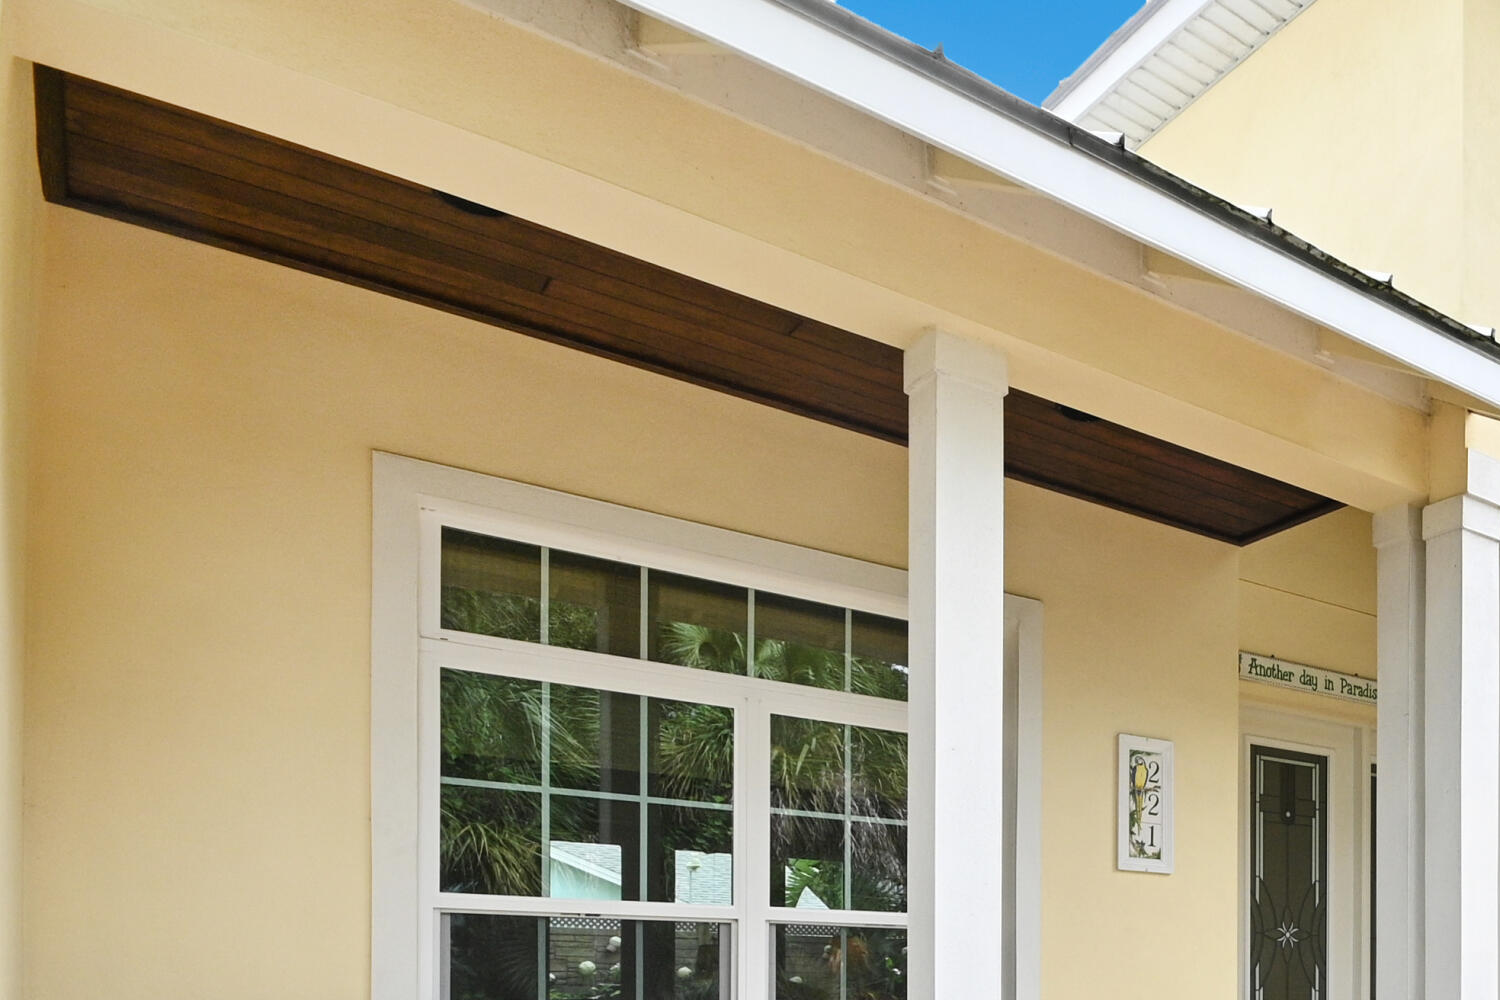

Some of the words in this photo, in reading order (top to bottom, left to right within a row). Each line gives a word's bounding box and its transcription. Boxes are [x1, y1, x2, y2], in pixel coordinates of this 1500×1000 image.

[1248, 658, 1294, 682] Another
[1299, 669, 1318, 691] day
[1324, 675, 1334, 691] in
[1340, 678, 1377, 699] Paradis
[1148, 761, 1160, 847] 221
